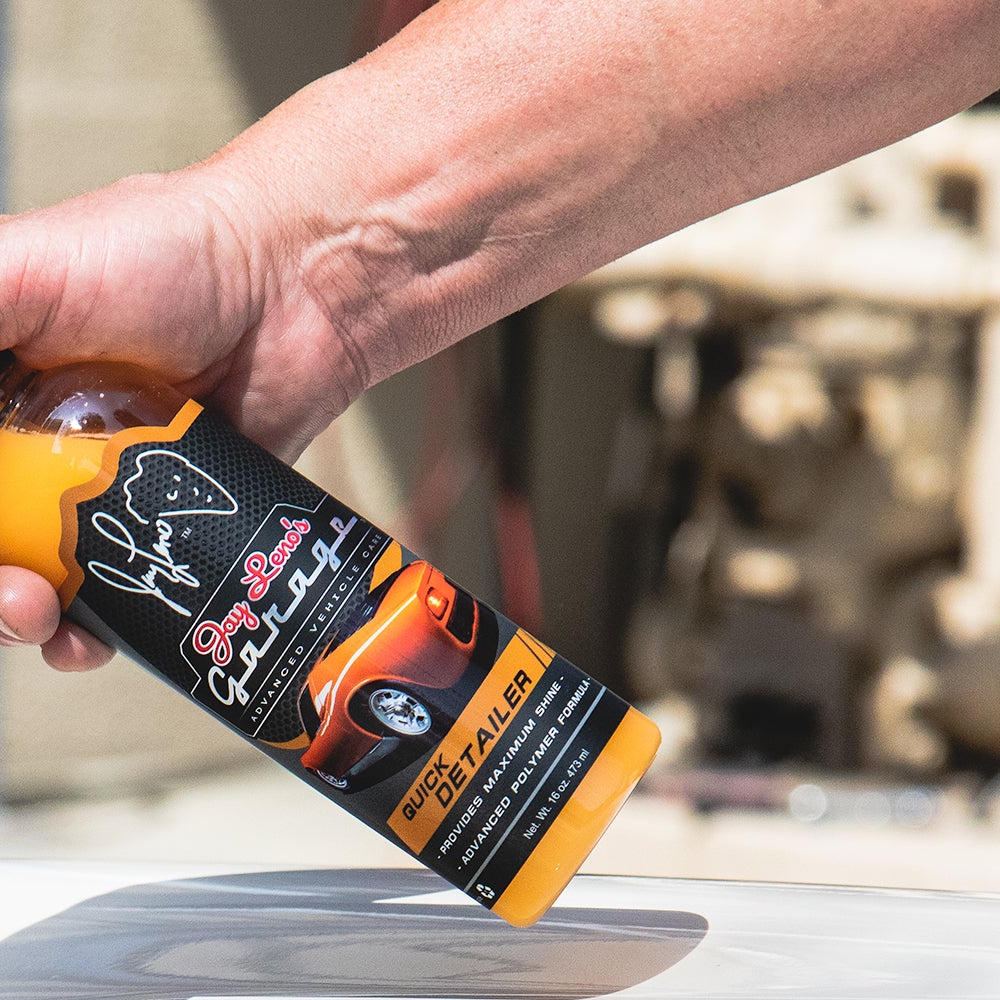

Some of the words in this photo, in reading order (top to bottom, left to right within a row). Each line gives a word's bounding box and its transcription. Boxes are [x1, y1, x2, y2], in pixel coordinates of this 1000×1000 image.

[193, 600, 260, 666] Jay
[240, 516, 310, 600] Leno's
[208, 516, 358, 706] Garage
[251, 645, 304, 722] ADVANCED
[309, 565, 360, 633] VEHICLE
[362, 534, 382, 558] CARE
[402, 752, 450, 822] QUICK
[434, 669, 532, 809] DETAILER
[440, 795, 483, 855] PROVIDES
[483, 718, 537, 794] MAXIMUM
[534, 681, 561, 718] SHINE
[461, 796, 511, 866] ADVANCED
[510, 726, 559, 794] POLYMER
[557, 679, 591, 726] FORMULA
[523, 822, 540, 840] Net.
[535, 804, 553, 822] Wt.
[548, 790, 560, 804] 16
[557, 779, 571, 792] oz.
[566, 759, 582, 778] 473
[578, 748, 590, 763] ml
